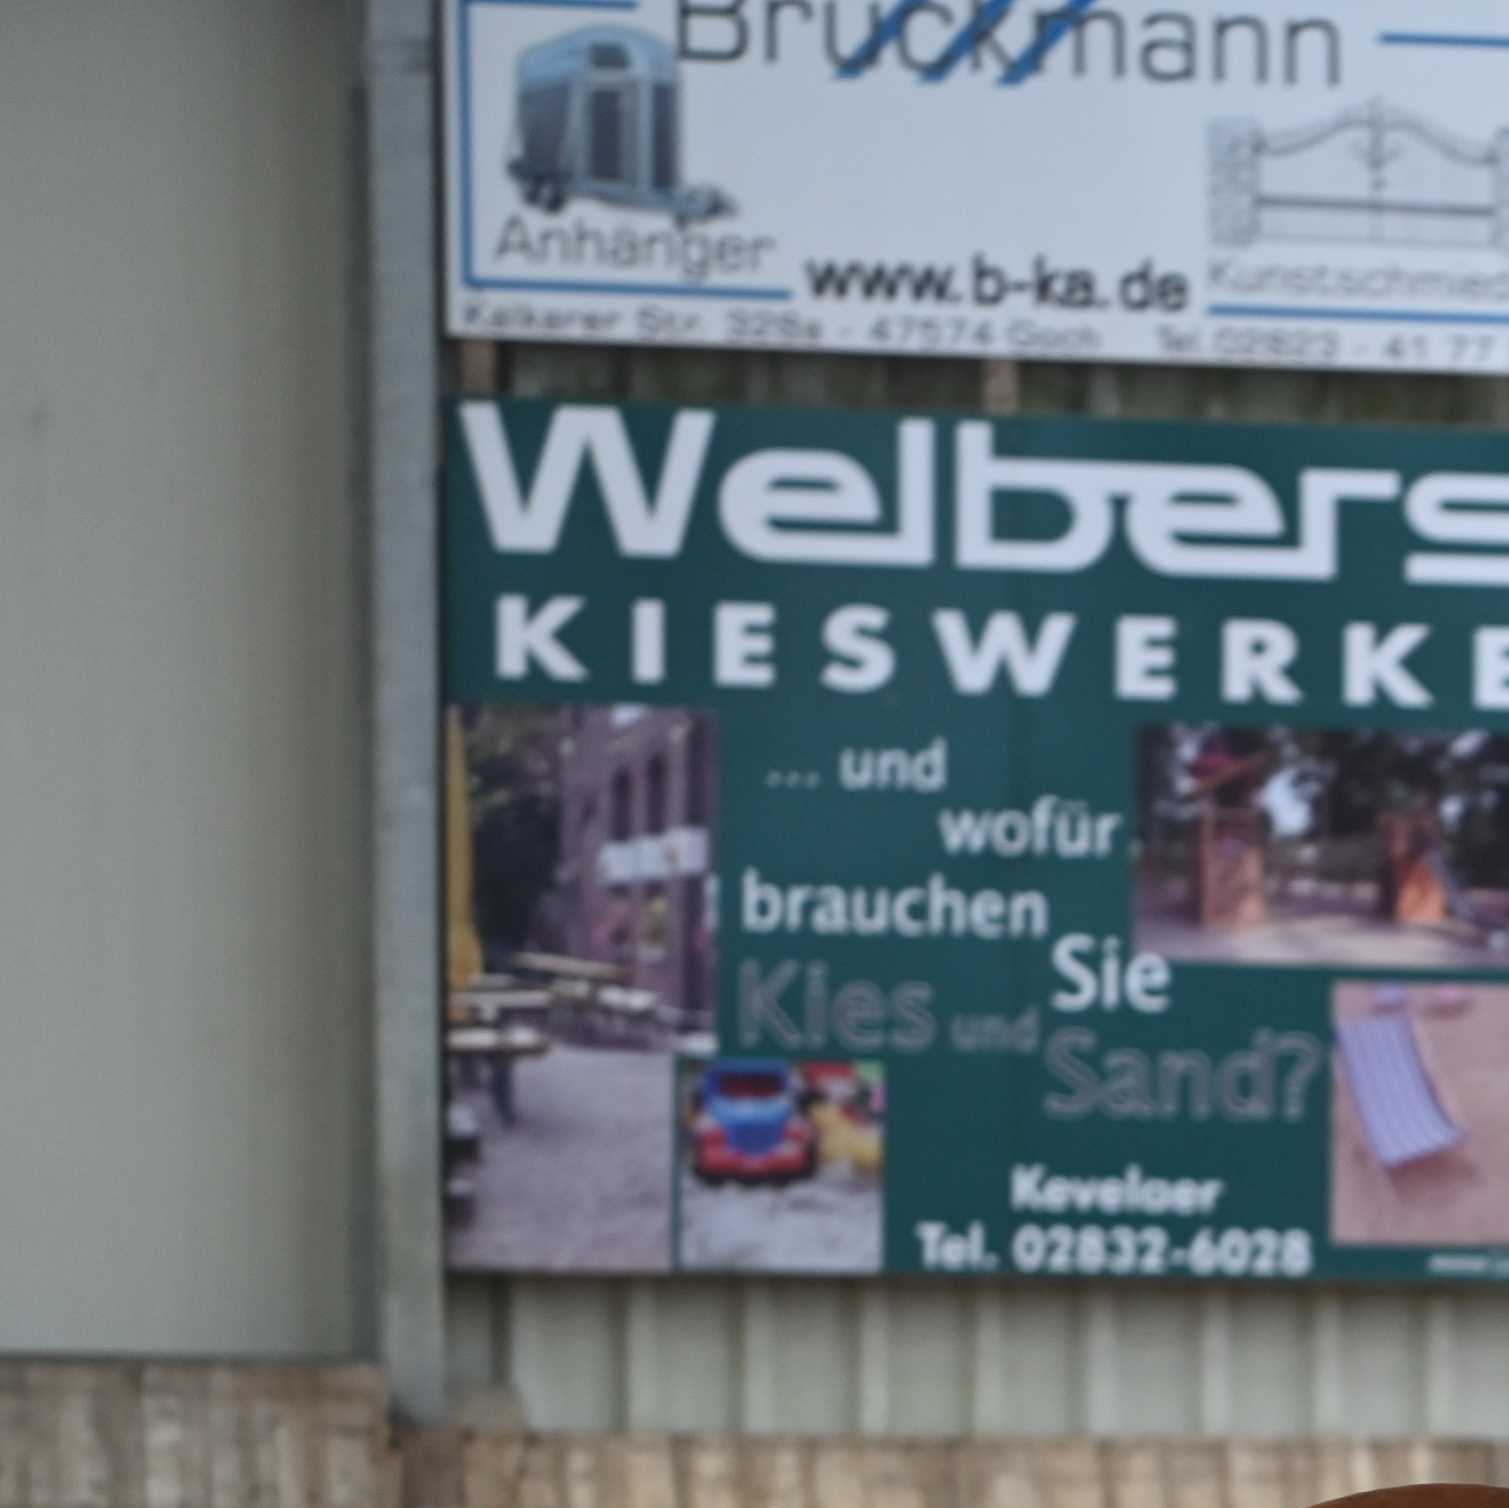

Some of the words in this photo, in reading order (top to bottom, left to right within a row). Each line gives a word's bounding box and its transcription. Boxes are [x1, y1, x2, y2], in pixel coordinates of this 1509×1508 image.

[805, 252, 1189, 313] www.b-ka.de
[838, 735, 949, 793] und
[937, 793, 1122, 859] wofür
[738, 866, 1050, 938] brauchen
[736, 956, 939, 1051] Kies
[950, 1007, 1042, 1054] und
[1048, 931, 1173, 1014] Sie
[1043, 1024, 1324, 1121] Sand?
[1010, 1163, 1225, 1215] Kevelaer
[916, 1220, 1000, 1271] Tel.
[1011, 1223, 1314, 1278] 02832-6028
